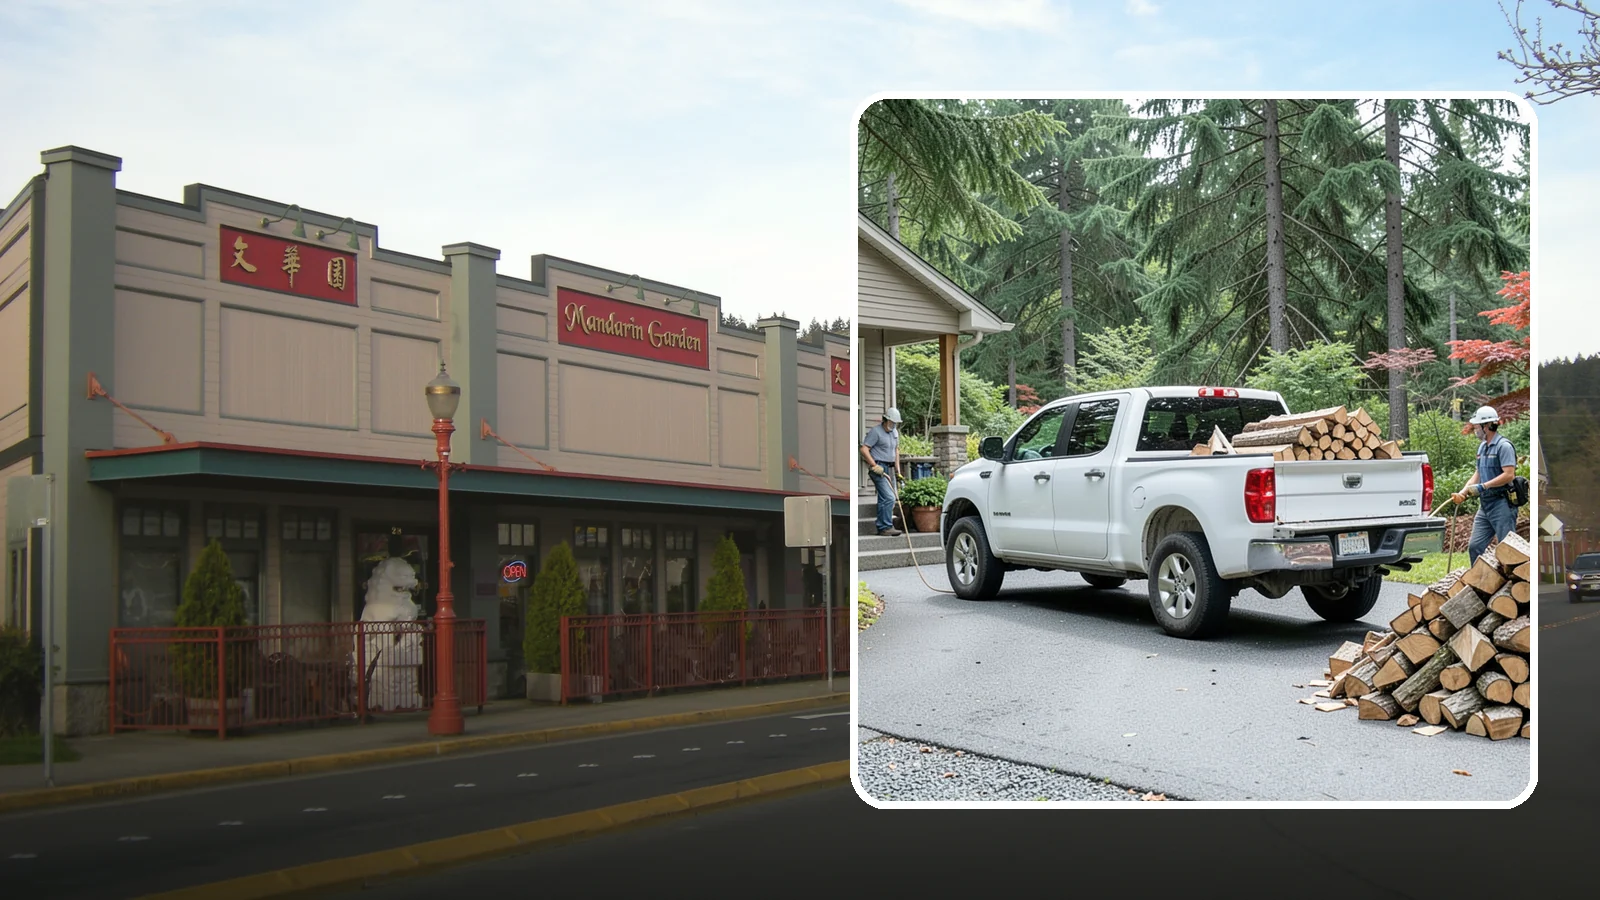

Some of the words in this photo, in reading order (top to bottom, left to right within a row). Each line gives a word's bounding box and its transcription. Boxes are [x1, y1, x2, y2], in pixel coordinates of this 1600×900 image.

[230, 235, 346, 291] 文華園
[564, 302, 644, 341] Mandarin
[647, 320, 702, 352] Garden
[503, 565, 527, 578] OPEN
